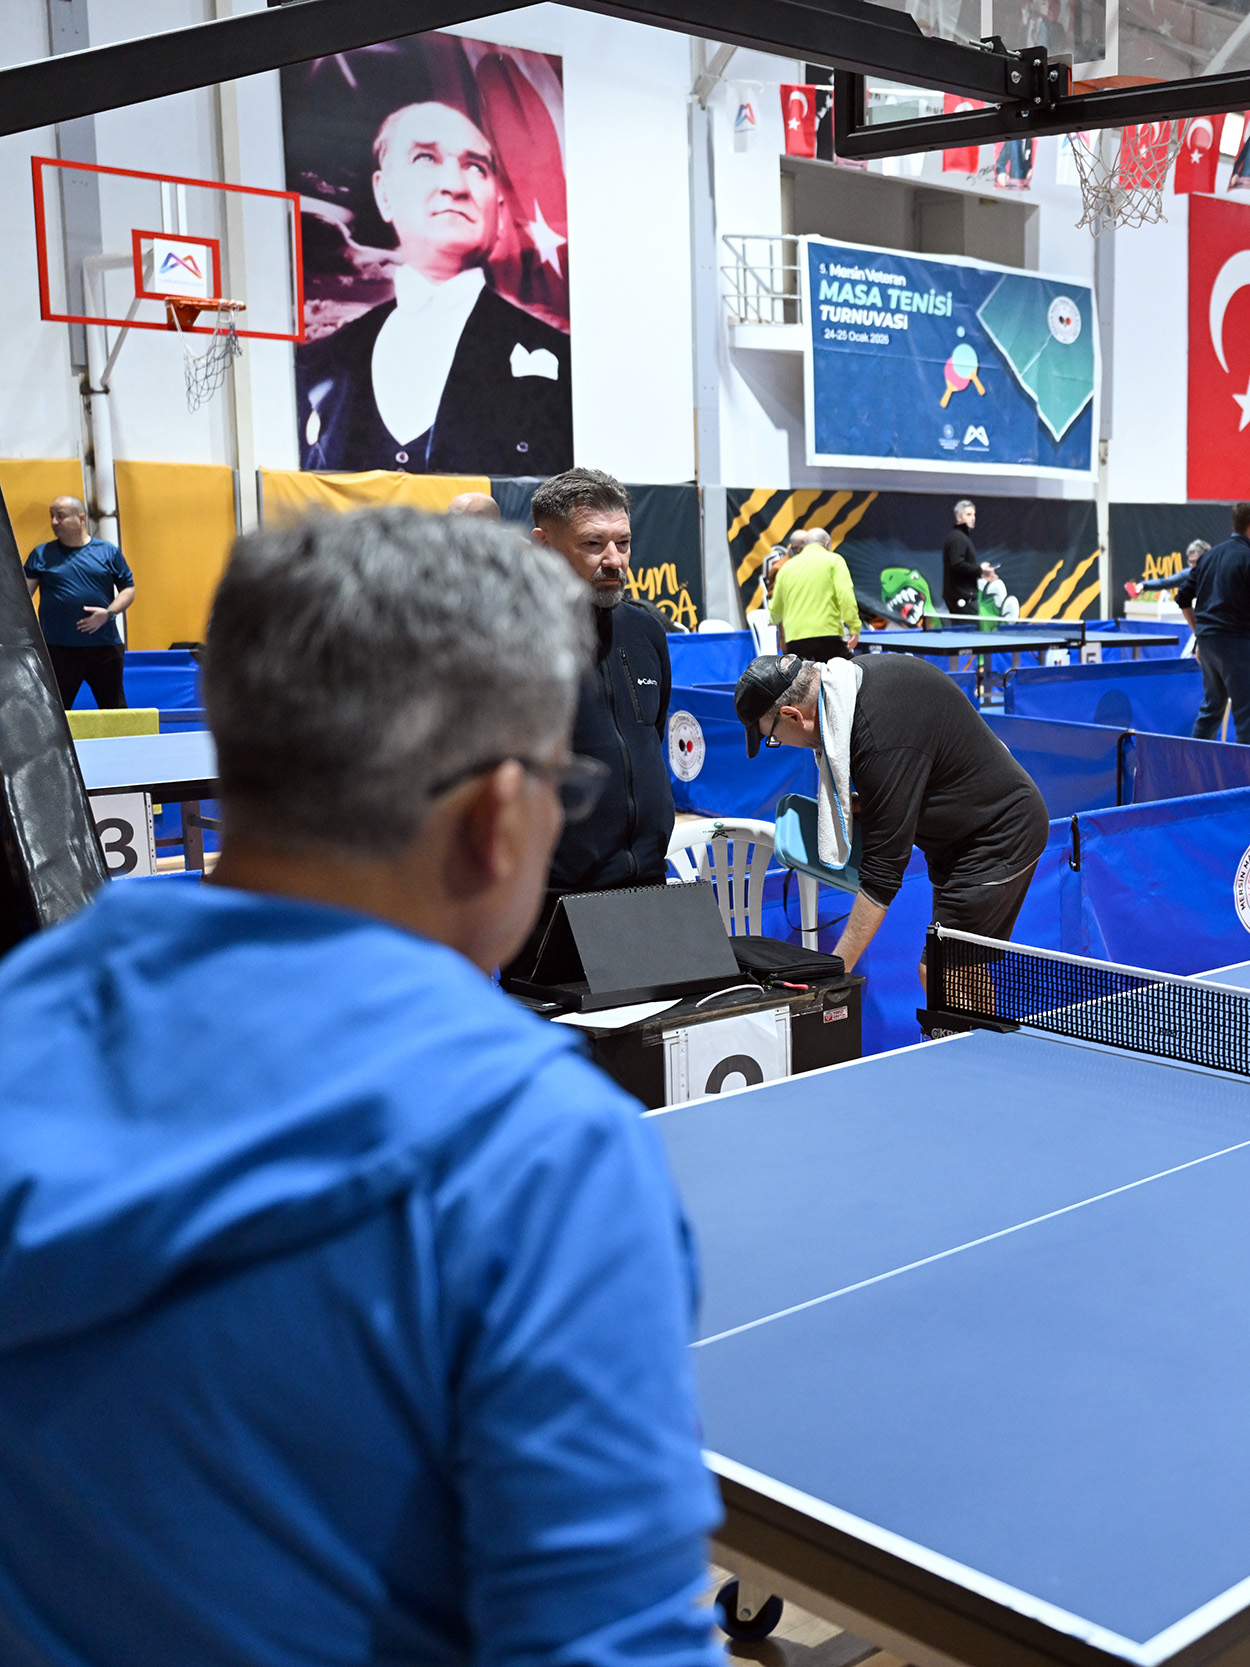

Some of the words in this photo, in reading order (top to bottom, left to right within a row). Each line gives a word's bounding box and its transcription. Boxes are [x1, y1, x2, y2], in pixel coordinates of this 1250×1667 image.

[829, 263, 866, 281] Mersin
[865, 269, 907, 287] Veteran
[818, 279, 883, 308] MASA
[887, 287, 953, 317] TENİSİ
[819, 304, 909, 330] TURNUVASI
[849, 330, 870, 343] Ocak
[870, 333, 889, 345] 2026
[95, 817, 138, 877] 3
